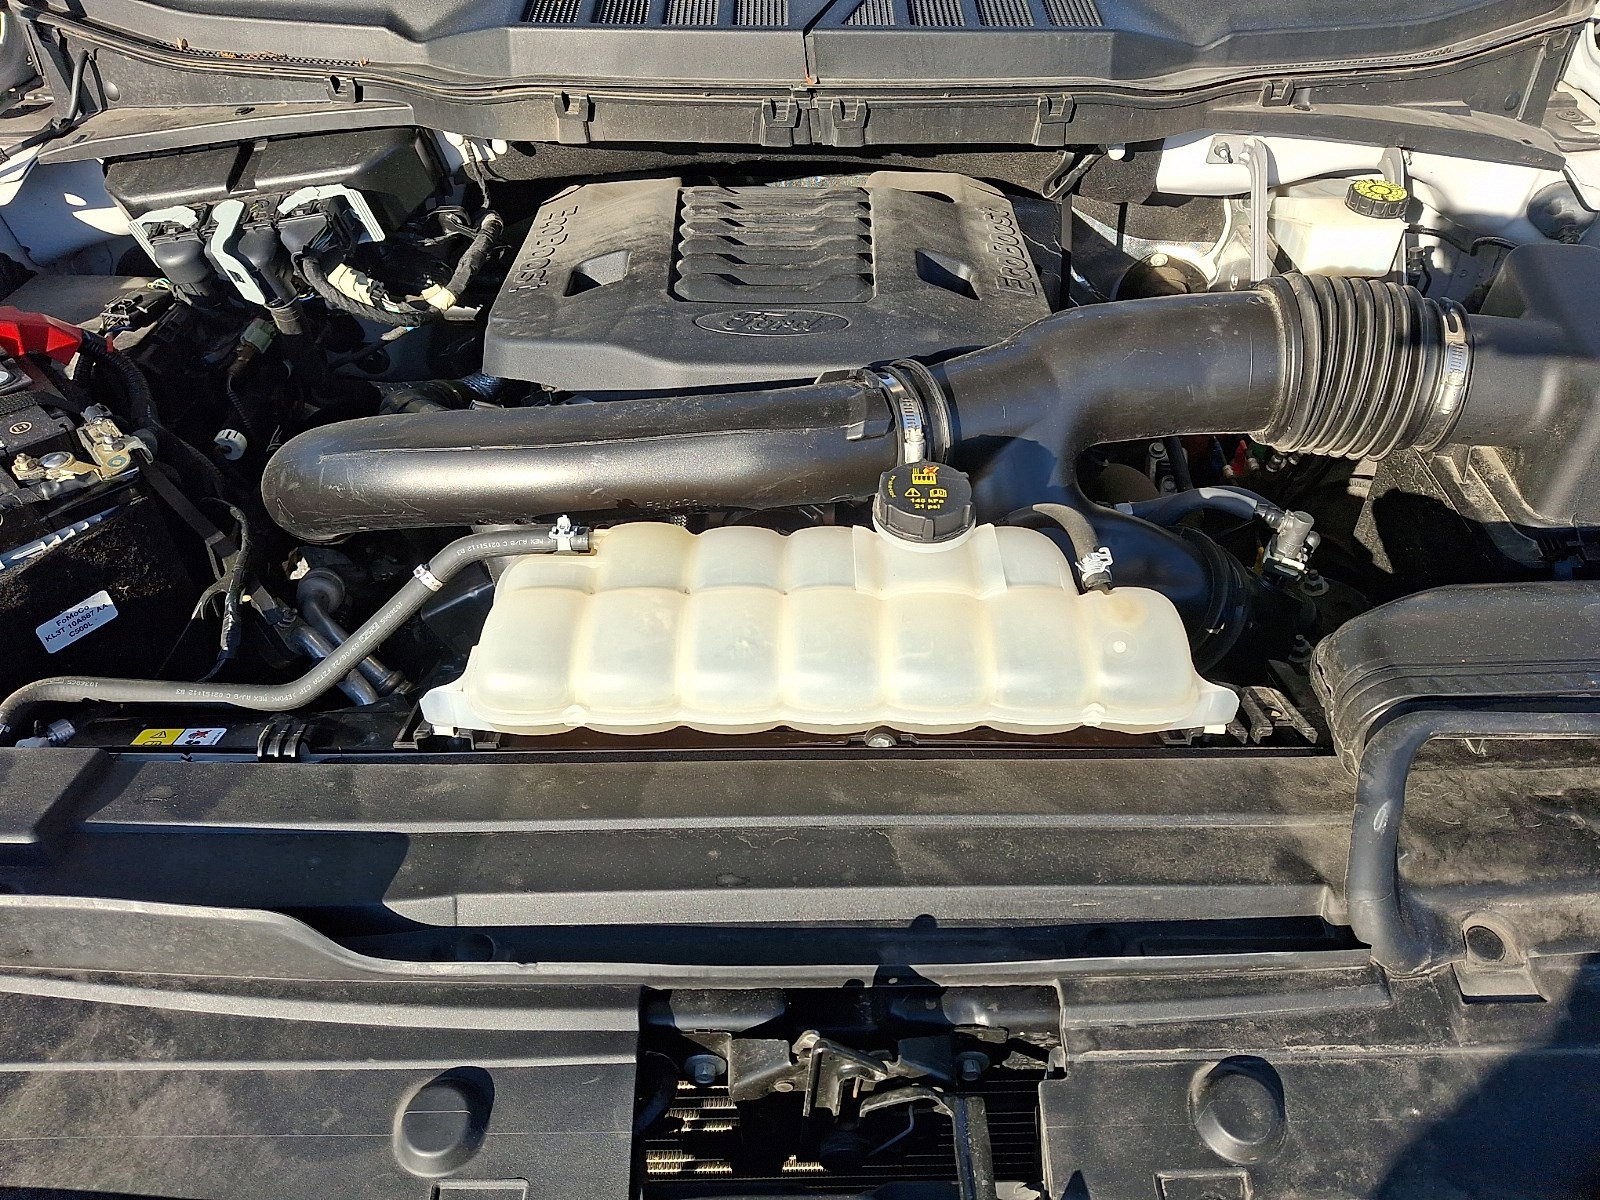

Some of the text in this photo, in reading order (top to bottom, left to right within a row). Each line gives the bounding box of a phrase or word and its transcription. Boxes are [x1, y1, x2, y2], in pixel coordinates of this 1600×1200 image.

[977, 206, 1037, 296] EcoBoost
[722, 311, 824, 332] Ford
[45, 626, 66, 643] KL3T
[96, 603, 109, 613] AA
[56, 605, 90, 627] FoMoCo
[69, 621, 94, 638] C500L
